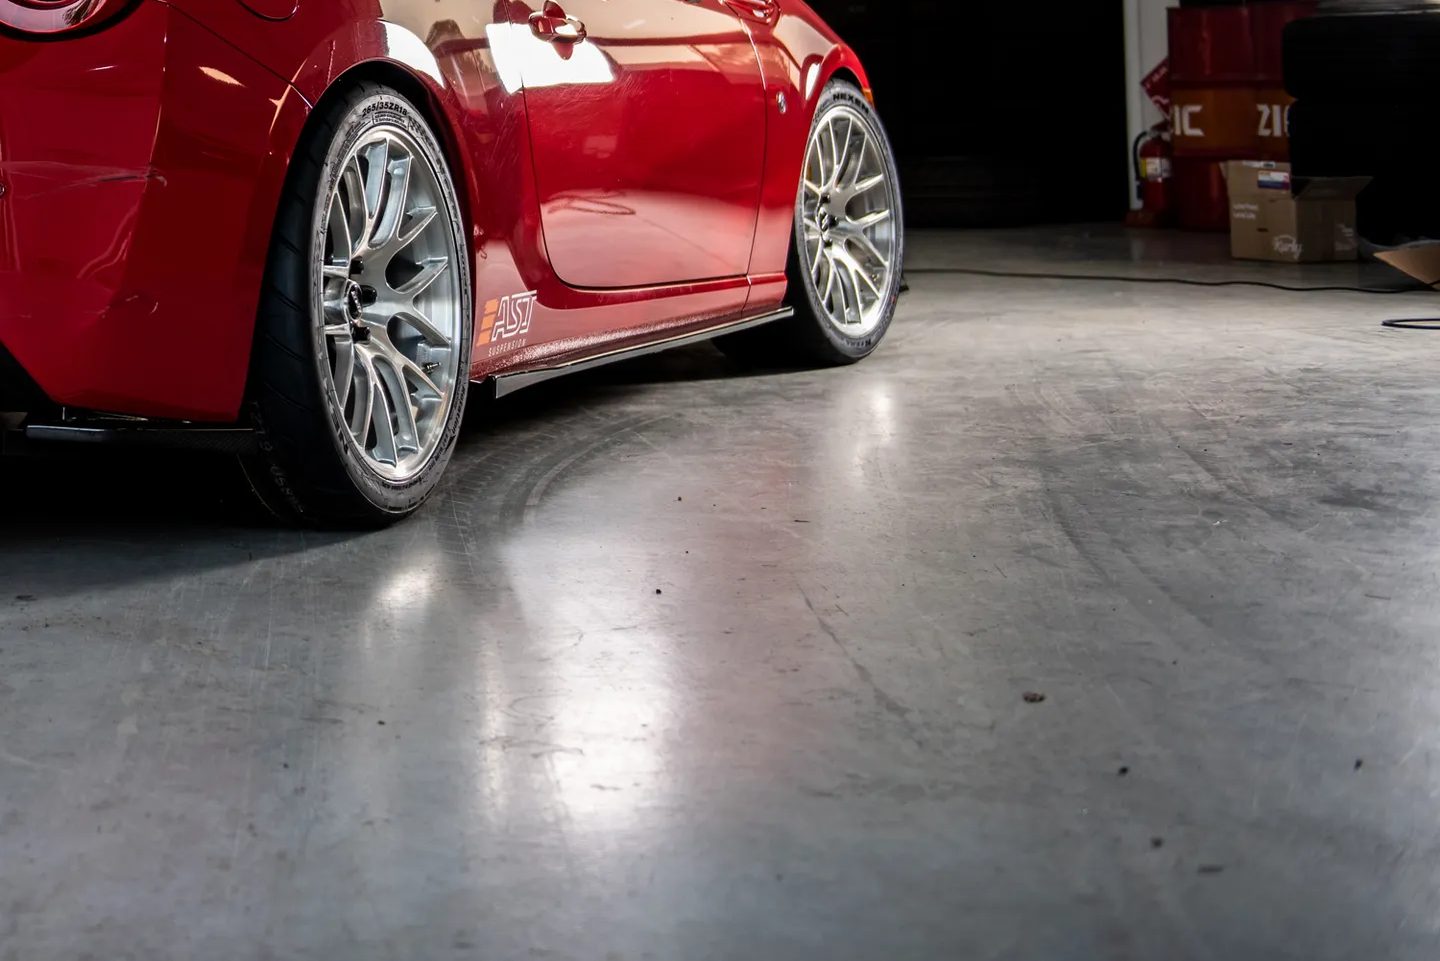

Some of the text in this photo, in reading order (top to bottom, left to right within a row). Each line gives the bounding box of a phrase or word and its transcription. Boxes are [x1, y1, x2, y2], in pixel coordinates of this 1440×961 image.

[361, 101, 409, 117] 265/35ZR18
[832, 92, 870, 115] NEXEN
[1172, 104, 1205, 136] IC
[491, 290, 537, 342] AST
[488, 338, 527, 357] SUSPENSION
